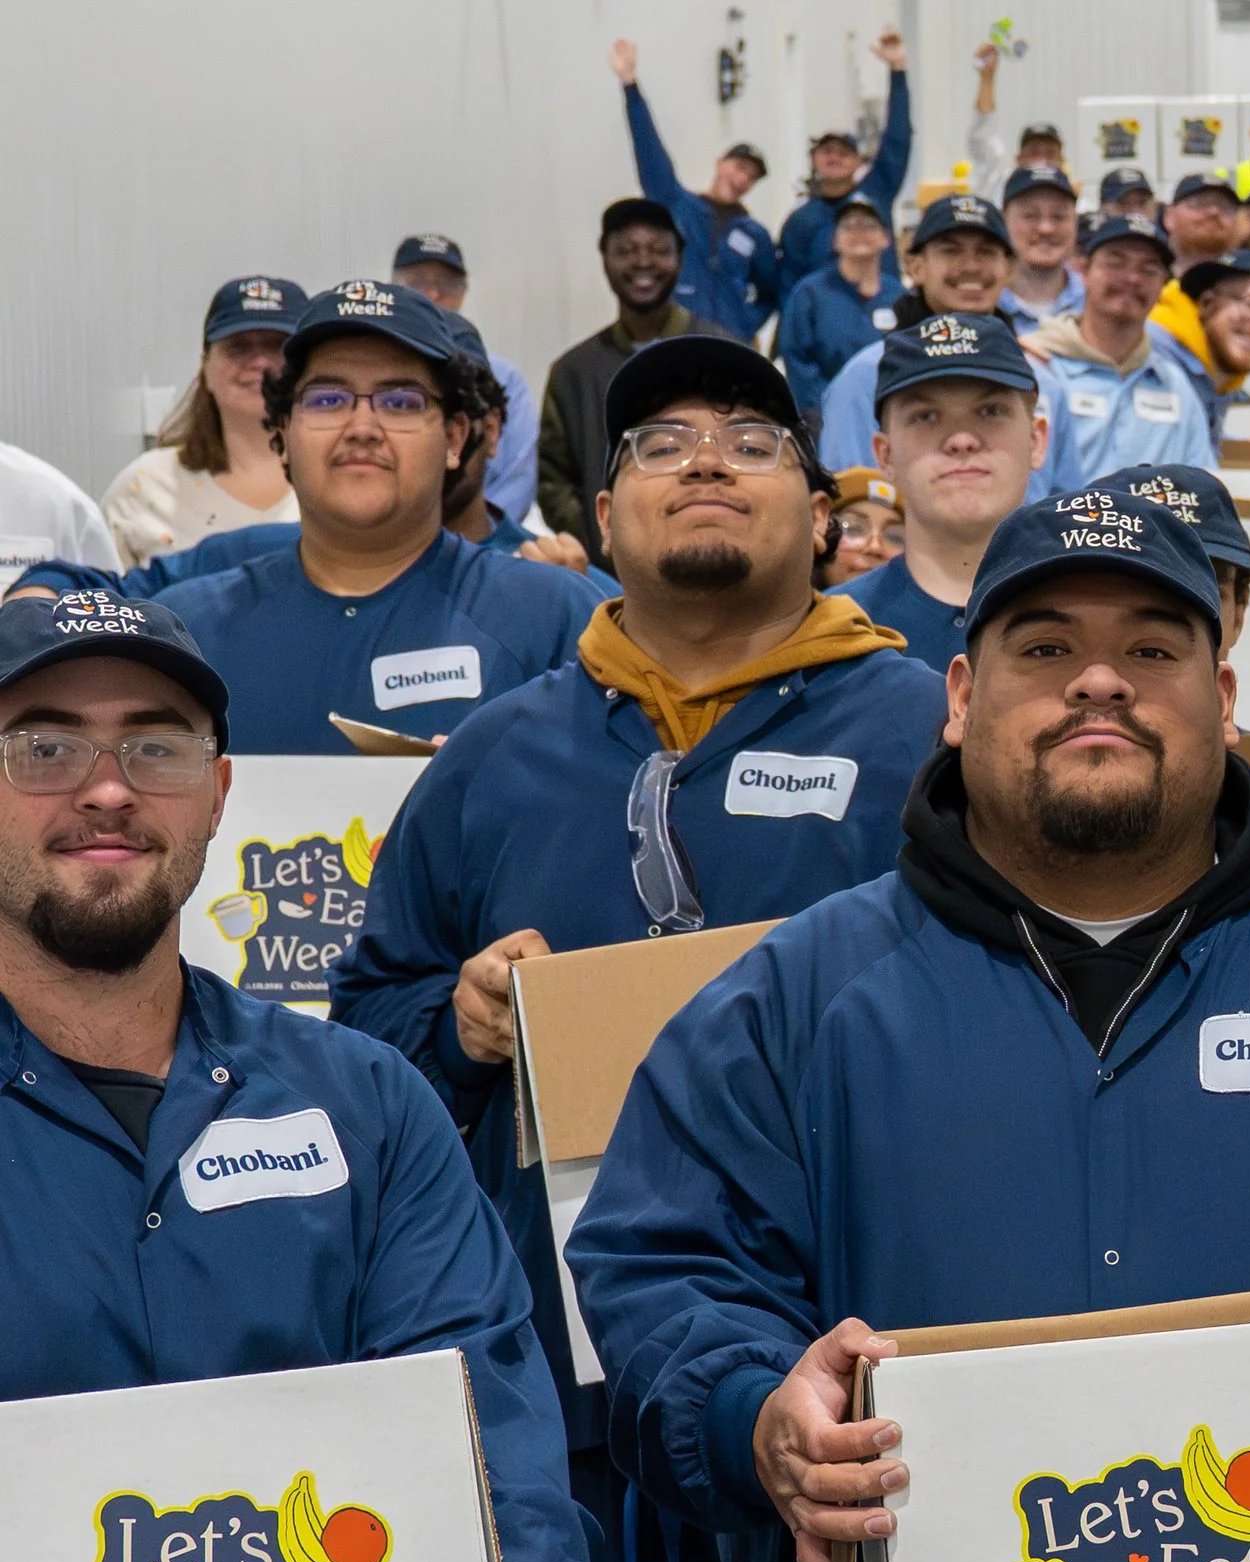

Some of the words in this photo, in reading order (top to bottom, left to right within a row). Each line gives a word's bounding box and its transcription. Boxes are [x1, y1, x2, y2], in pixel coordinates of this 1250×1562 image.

[337, 301, 394, 316] Week
[920, 315, 958, 338] Let's
[949, 325, 979, 341] Eat
[924, 340, 979, 357] Week
[1129, 475, 1174, 497] Let's
[1055, 491, 1114, 513] Let's
[1166, 491, 1200, 507] Eat
[1100, 510, 1144, 533] Eat
[1060, 528, 1141, 551] Week
[98, 604, 147, 623] Eat
[56, 618, 139, 635] Week
[384, 665, 466, 690] Chobani
[739, 768, 837, 793] Chobani
[251, 847, 343, 889] Let's
[319, 887, 366, 928] Ea
[256, 932, 354, 972] Wee
[196, 1142, 326, 1181] Chobani
[1038, 1479, 1185, 1554] Let's
